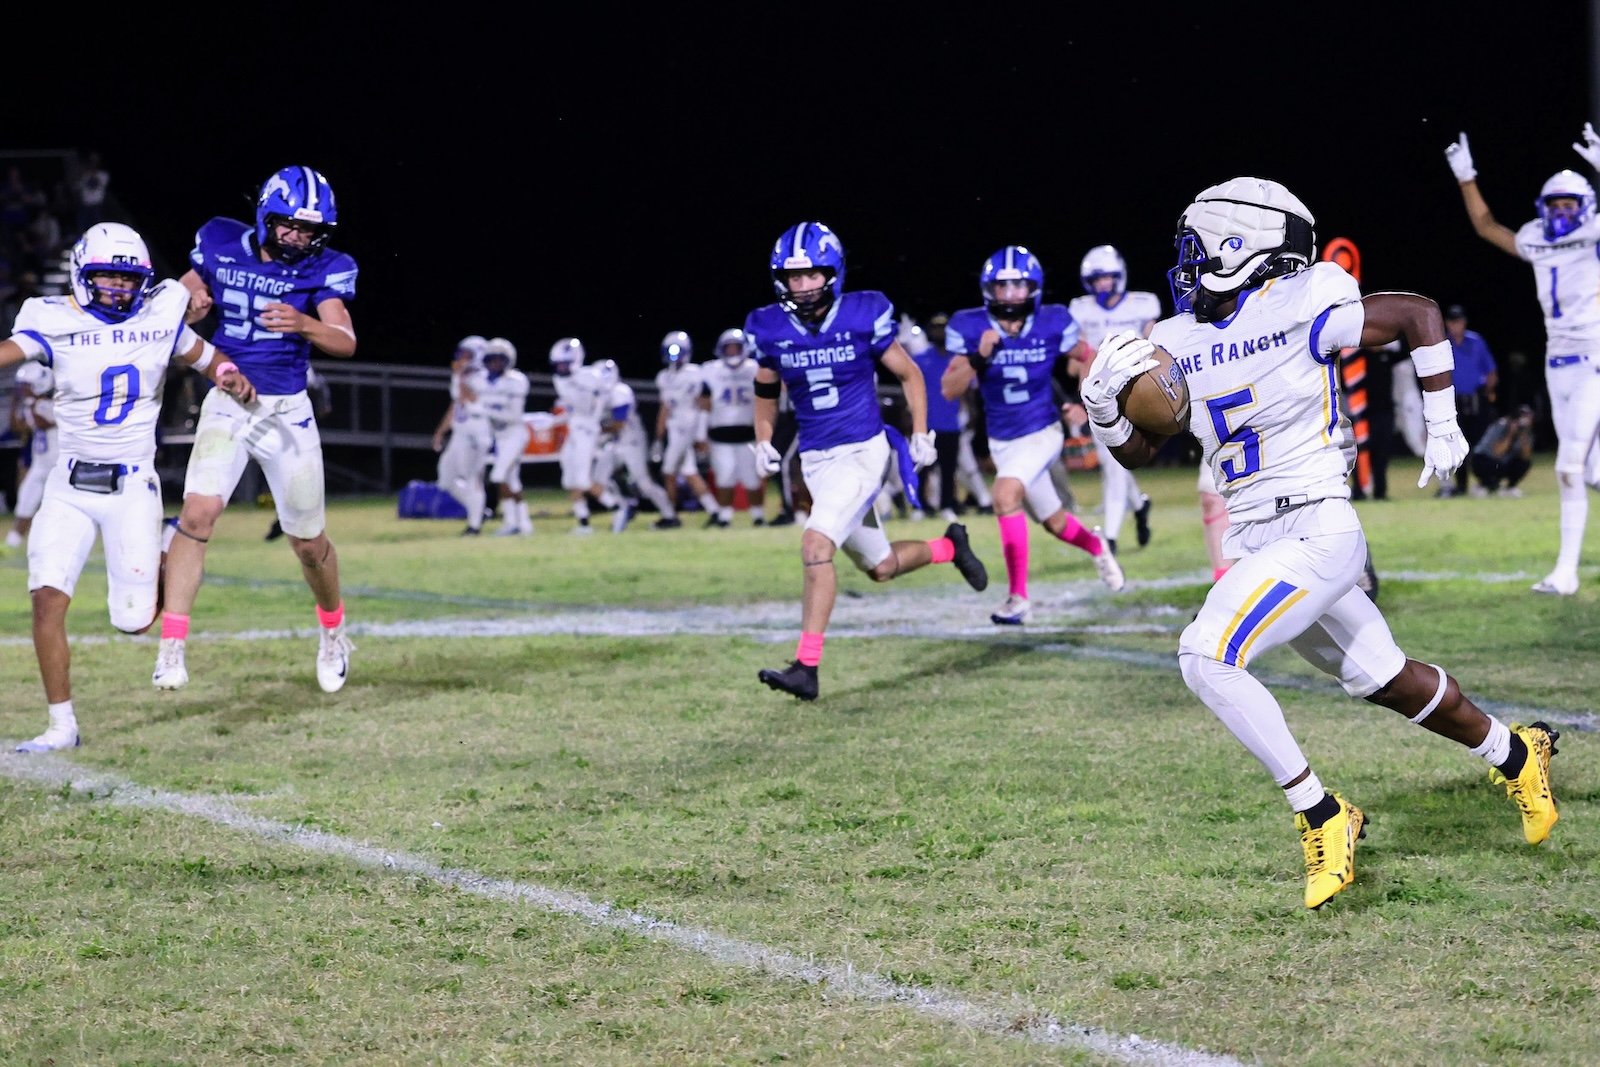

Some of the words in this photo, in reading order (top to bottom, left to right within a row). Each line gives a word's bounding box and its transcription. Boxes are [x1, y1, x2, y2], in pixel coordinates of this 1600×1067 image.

[1551, 267, 1563, 318] 1
[780, 345, 856, 368] MUSTANGS
[1177, 354, 1203, 375] HE
[1211, 331, 1287, 366] RANCH
[93, 362, 142, 427] 0
[805, 367, 840, 411] 5
[1002, 366, 1030, 404] 2
[1204, 385, 1262, 485] 5
